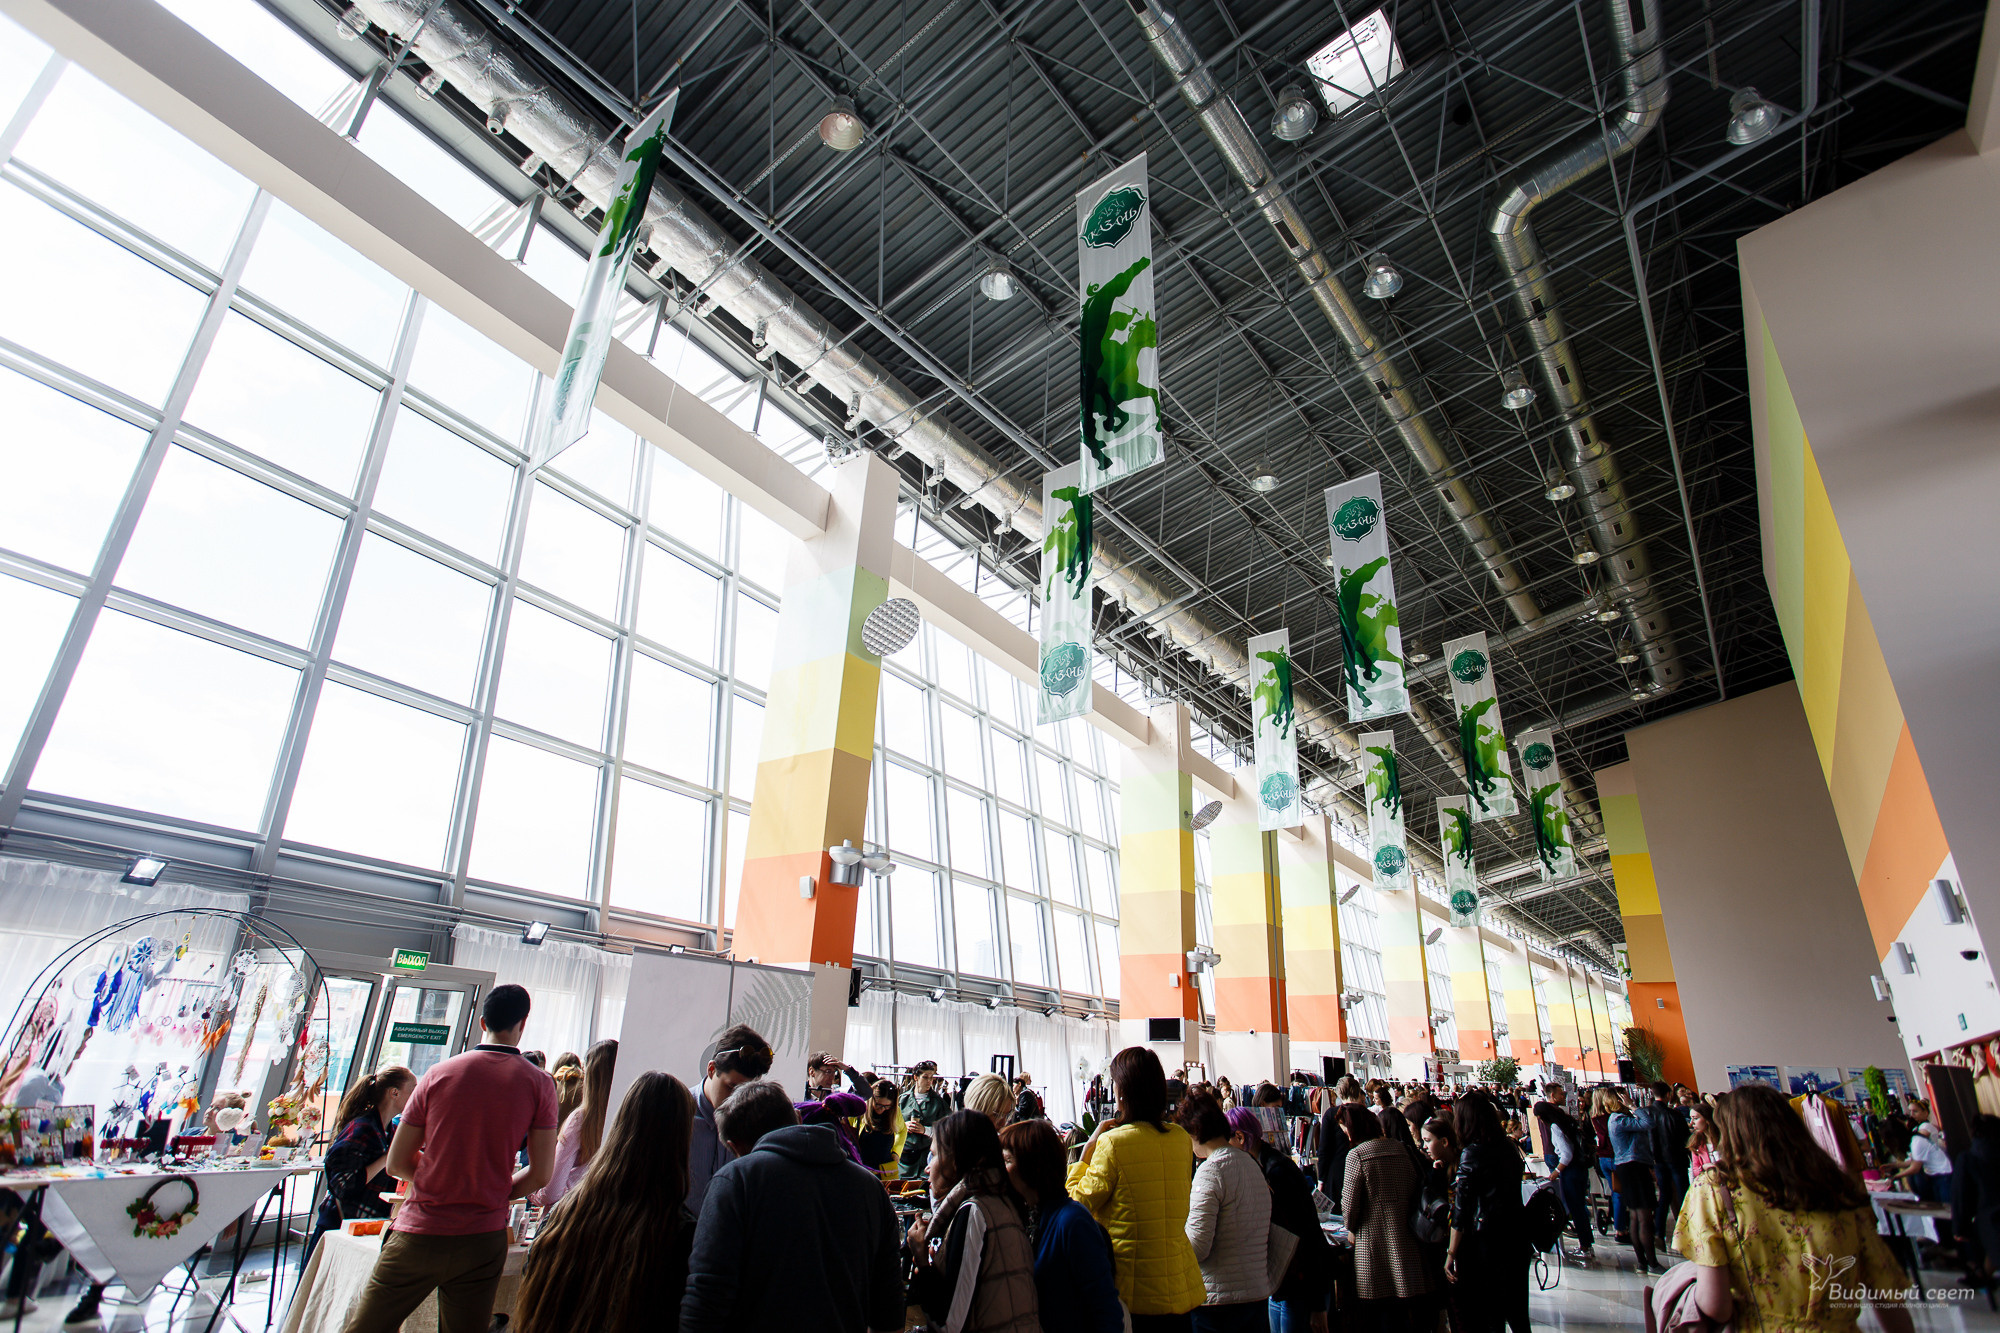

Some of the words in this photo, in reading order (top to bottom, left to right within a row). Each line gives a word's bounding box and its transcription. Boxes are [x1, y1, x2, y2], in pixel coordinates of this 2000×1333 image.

[1087, 207, 1137, 240] КАЗАНЬ
[1336, 514, 1376, 532] КАЗАНЬ
[1044, 666, 1084, 684] КАЗАНЬ
[396, 953, 427, 967] ВЫХОД
